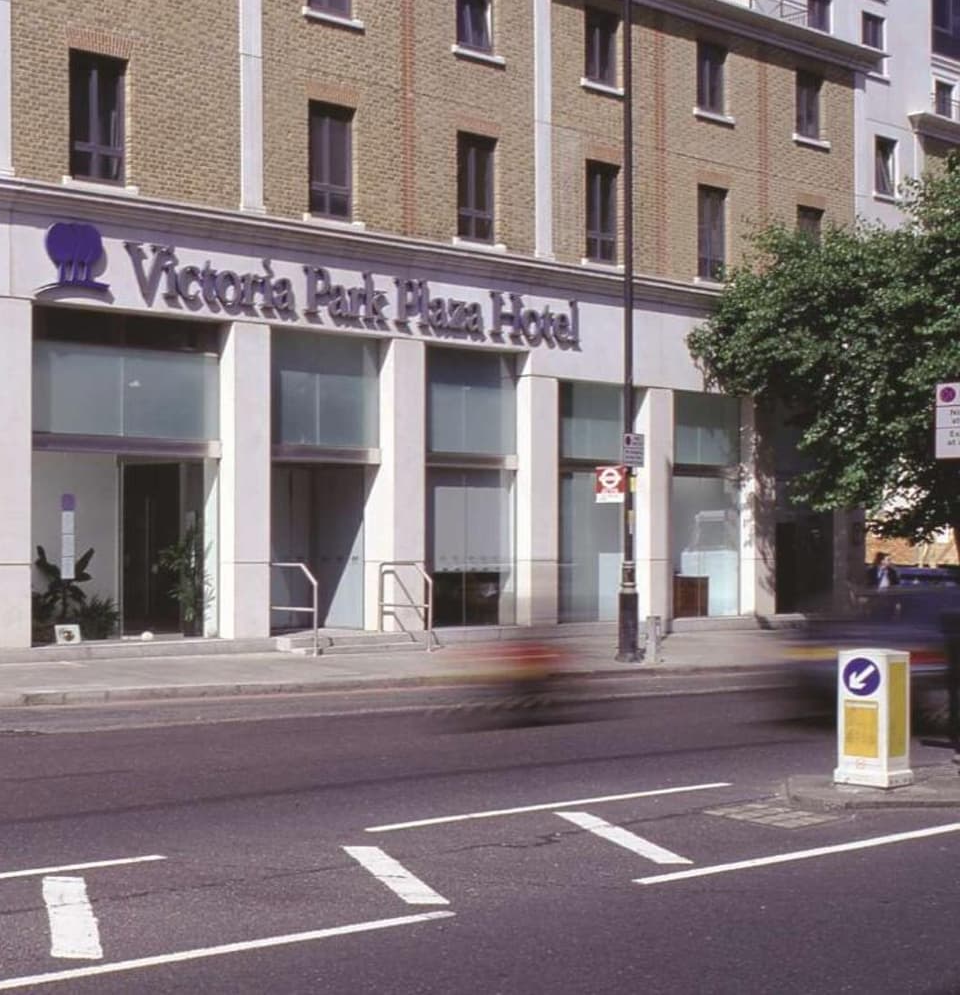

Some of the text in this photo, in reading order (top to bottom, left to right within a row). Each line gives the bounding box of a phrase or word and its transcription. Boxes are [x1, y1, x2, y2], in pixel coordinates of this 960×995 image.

[123, 240, 582, 352] Victoria Park Plaza Hotel
